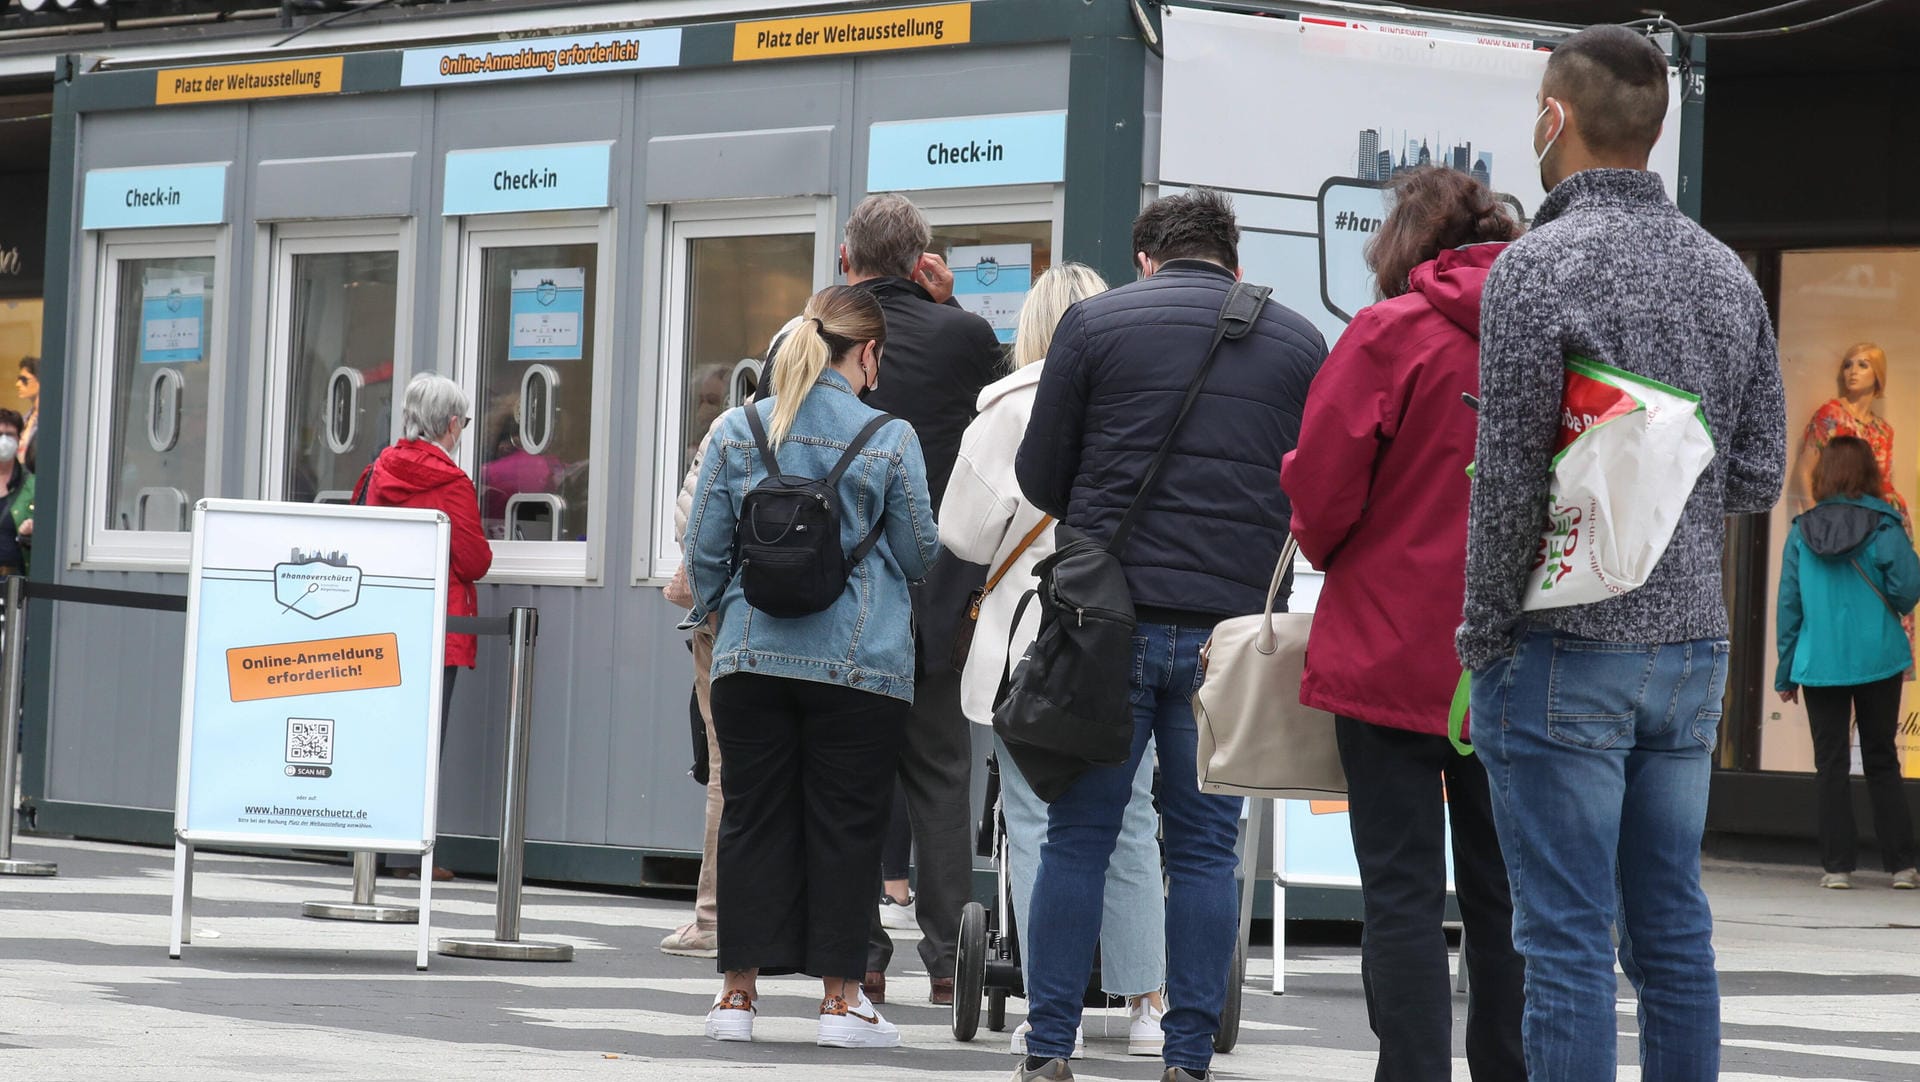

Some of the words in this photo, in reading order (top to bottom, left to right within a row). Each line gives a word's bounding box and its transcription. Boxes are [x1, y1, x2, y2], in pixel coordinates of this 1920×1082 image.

[757, 30, 791, 48] Platz
[795, 28, 819, 45] der
[824, 18, 944, 43] Weltausstellung
[440, 48, 556, 75] Online-Anmeldung
[558, 40, 640, 65] erforderlich!
[175, 77, 202, 94] Platz
[205, 75, 224, 91] der
[227, 69, 322, 89] Weltausstellung
[927, 139, 1004, 165] Check-in
[493, 167, 557, 191] Check-in
[126, 186, 180, 207] Check-in
[1335, 210, 1382, 232] #han
[281, 572, 353, 582] #hannoverschützt
[242, 645, 384, 671] Online-Anmeldung
[267, 664, 363, 685] erforderlich!
[297, 768, 315, 776] SCAN
[245, 805, 368, 820] www.hannoverschuetzt.de
